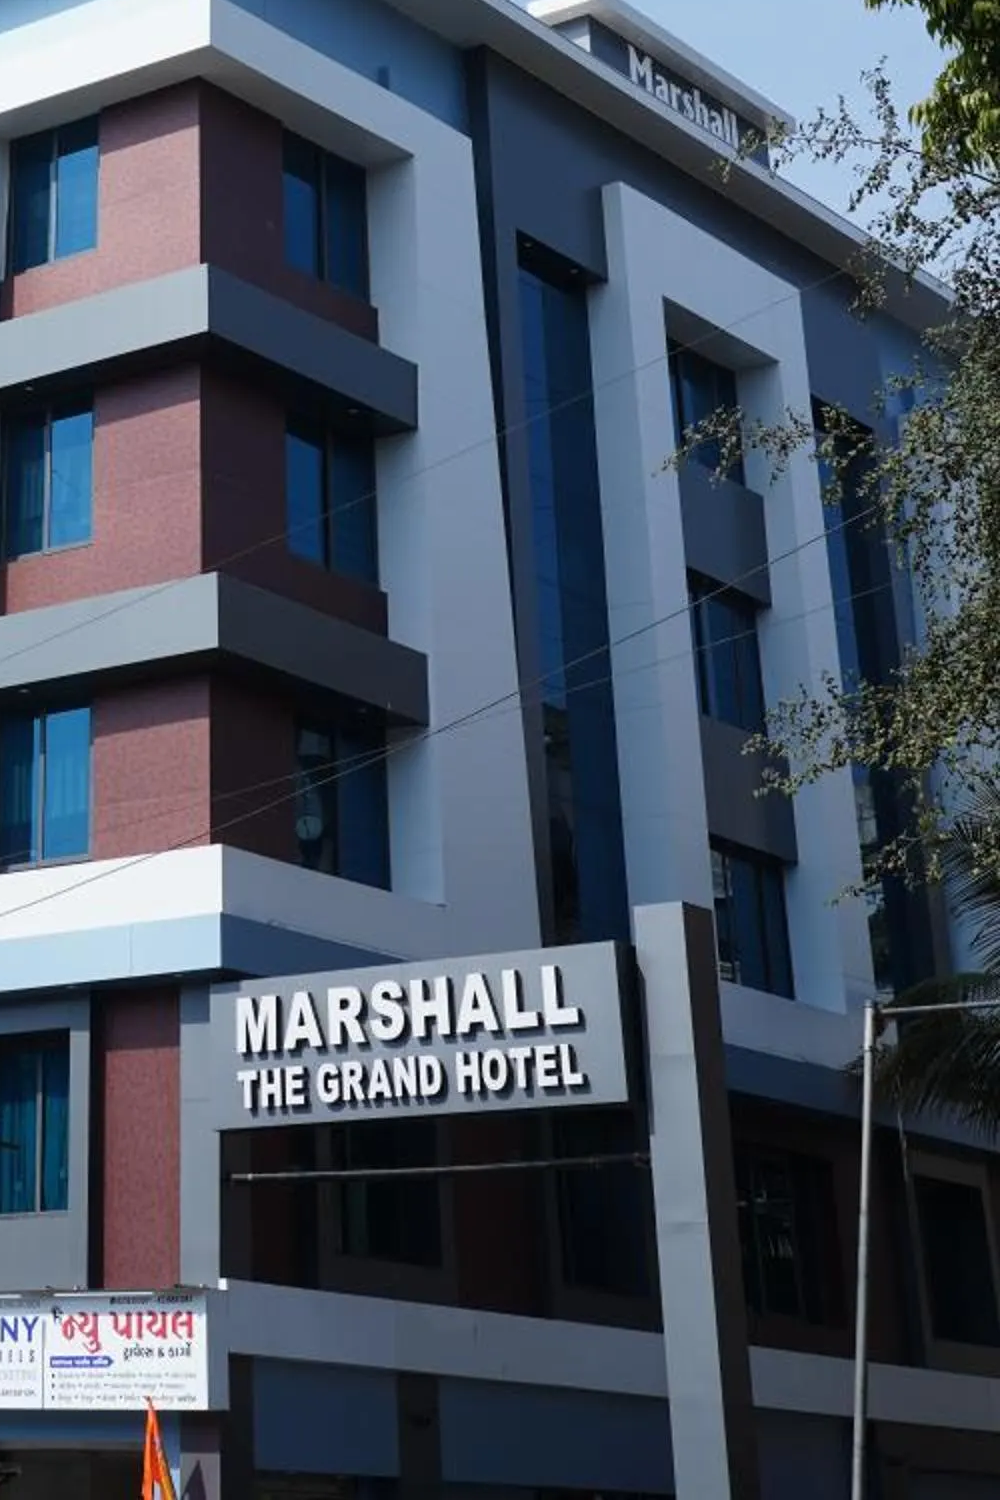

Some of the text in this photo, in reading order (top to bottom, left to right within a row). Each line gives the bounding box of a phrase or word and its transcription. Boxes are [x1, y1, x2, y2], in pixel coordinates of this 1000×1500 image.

[627, 44, 739, 149] Marshall
[235, 965, 581, 1055] MARSHALL
[237, 1043, 585, 1110] THE GRAND HOTEL
[109, 1309, 195, 1341] પાયલ
